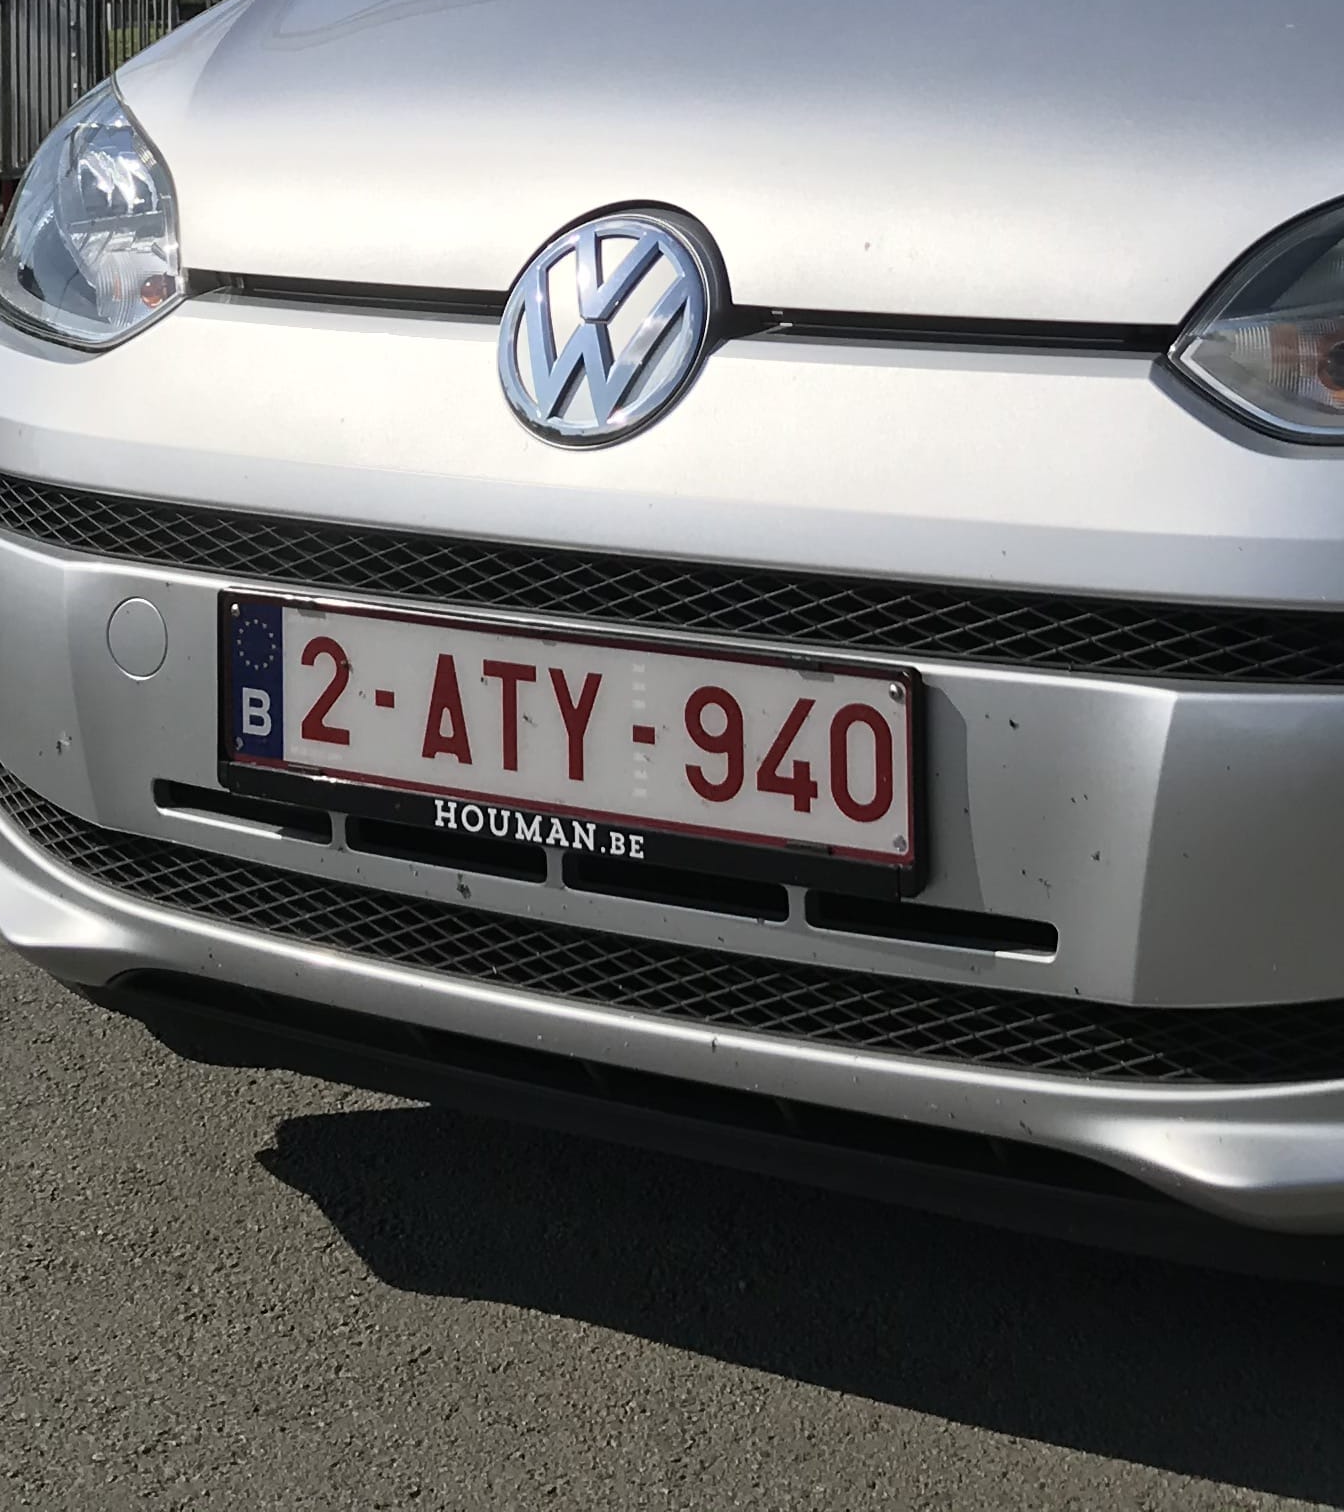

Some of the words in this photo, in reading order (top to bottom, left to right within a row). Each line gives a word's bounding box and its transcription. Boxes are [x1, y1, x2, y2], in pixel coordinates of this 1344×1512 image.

[504, 216, 704, 439] VW
[242, 687, 272, 736] B
[301, 636, 894, 823] 2-ATY-940
[434, 799, 645, 859] HOUMAN.BE
